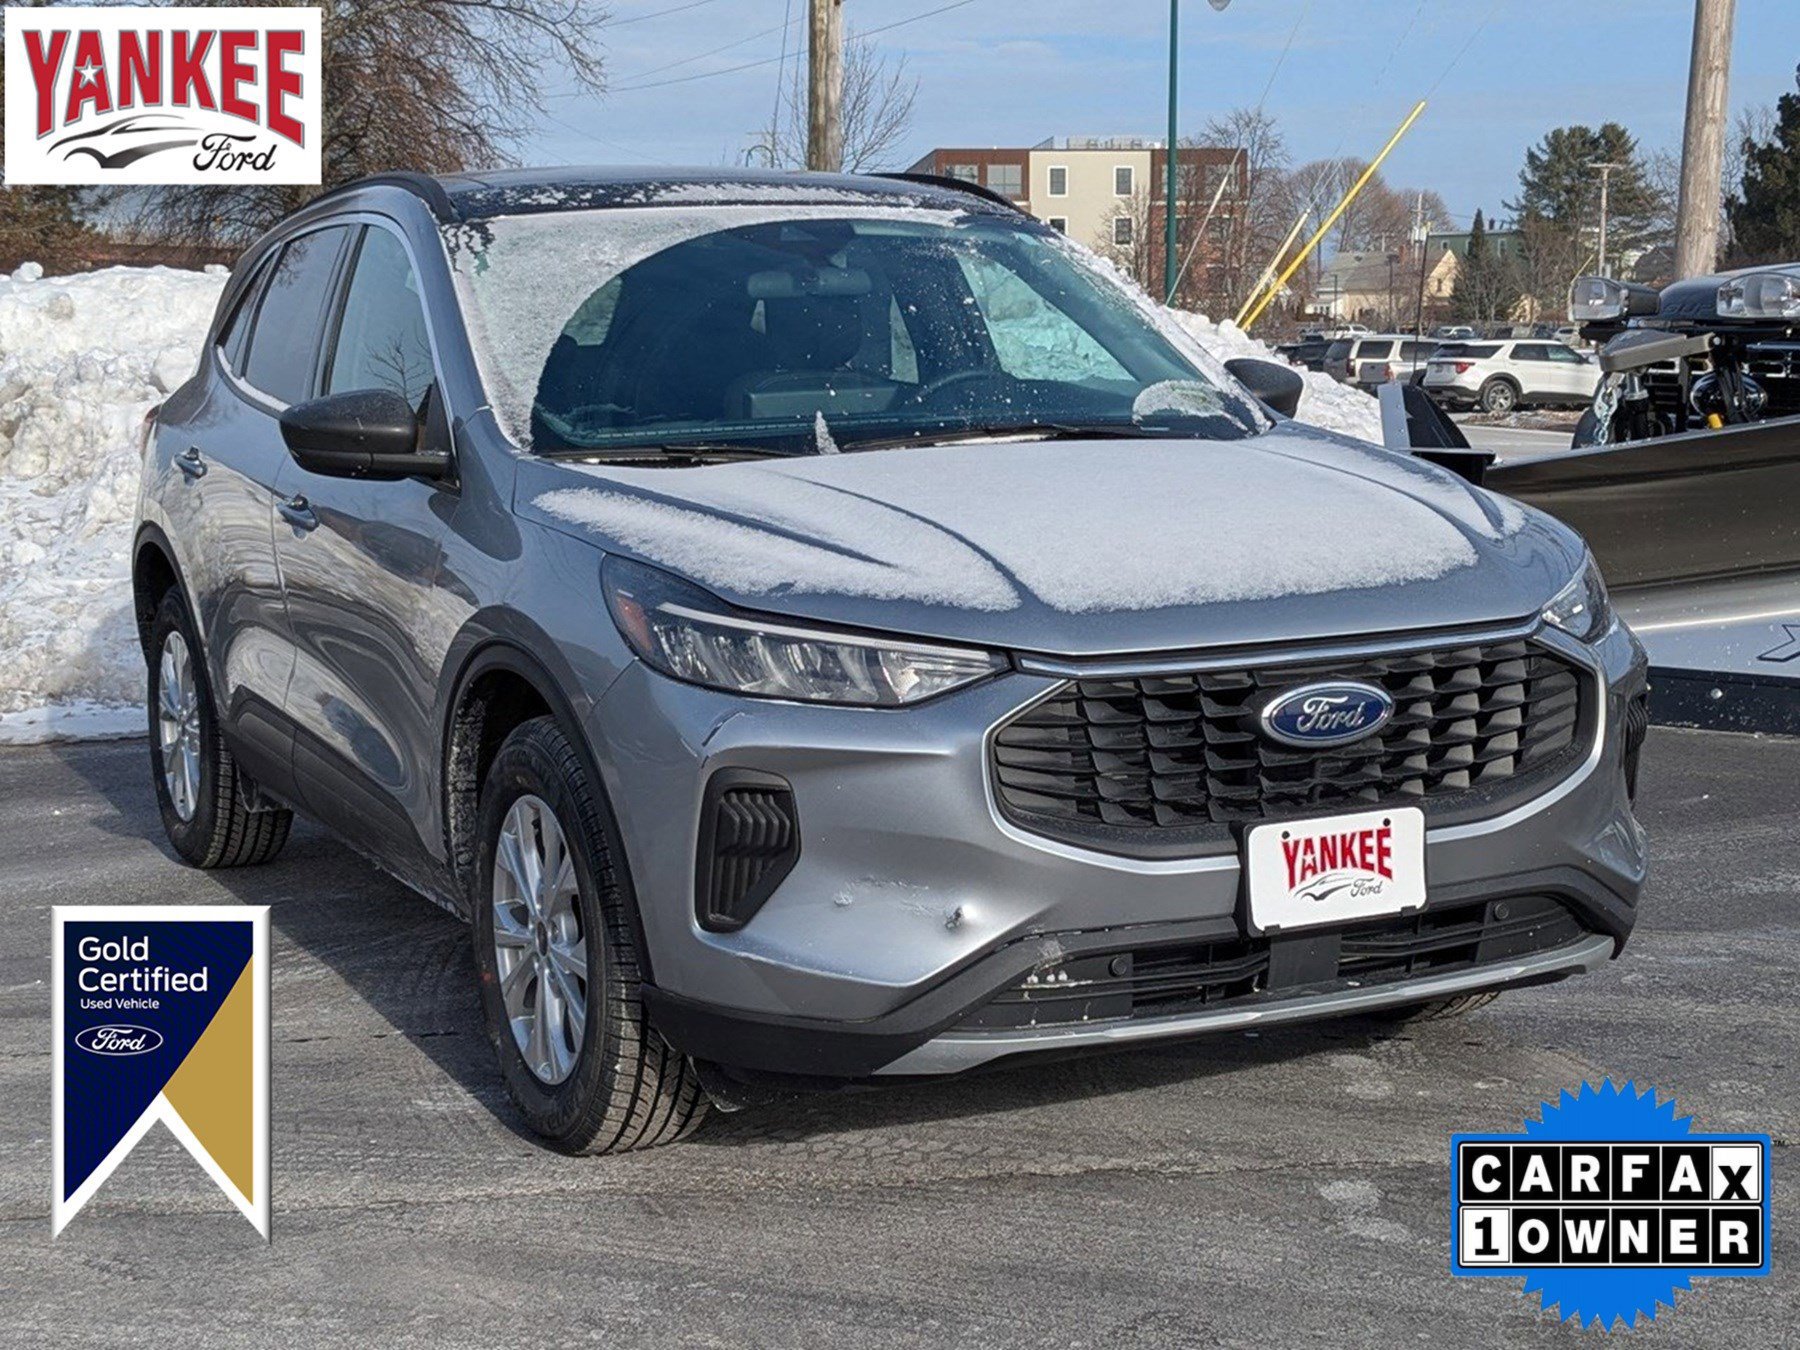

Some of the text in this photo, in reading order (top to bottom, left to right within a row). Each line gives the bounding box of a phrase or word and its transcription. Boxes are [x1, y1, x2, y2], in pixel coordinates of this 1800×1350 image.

[1296, 696, 1366, 732] Ford
[1281, 828, 1393, 891] YANKEE
[1350, 878, 1383, 897] Ford
